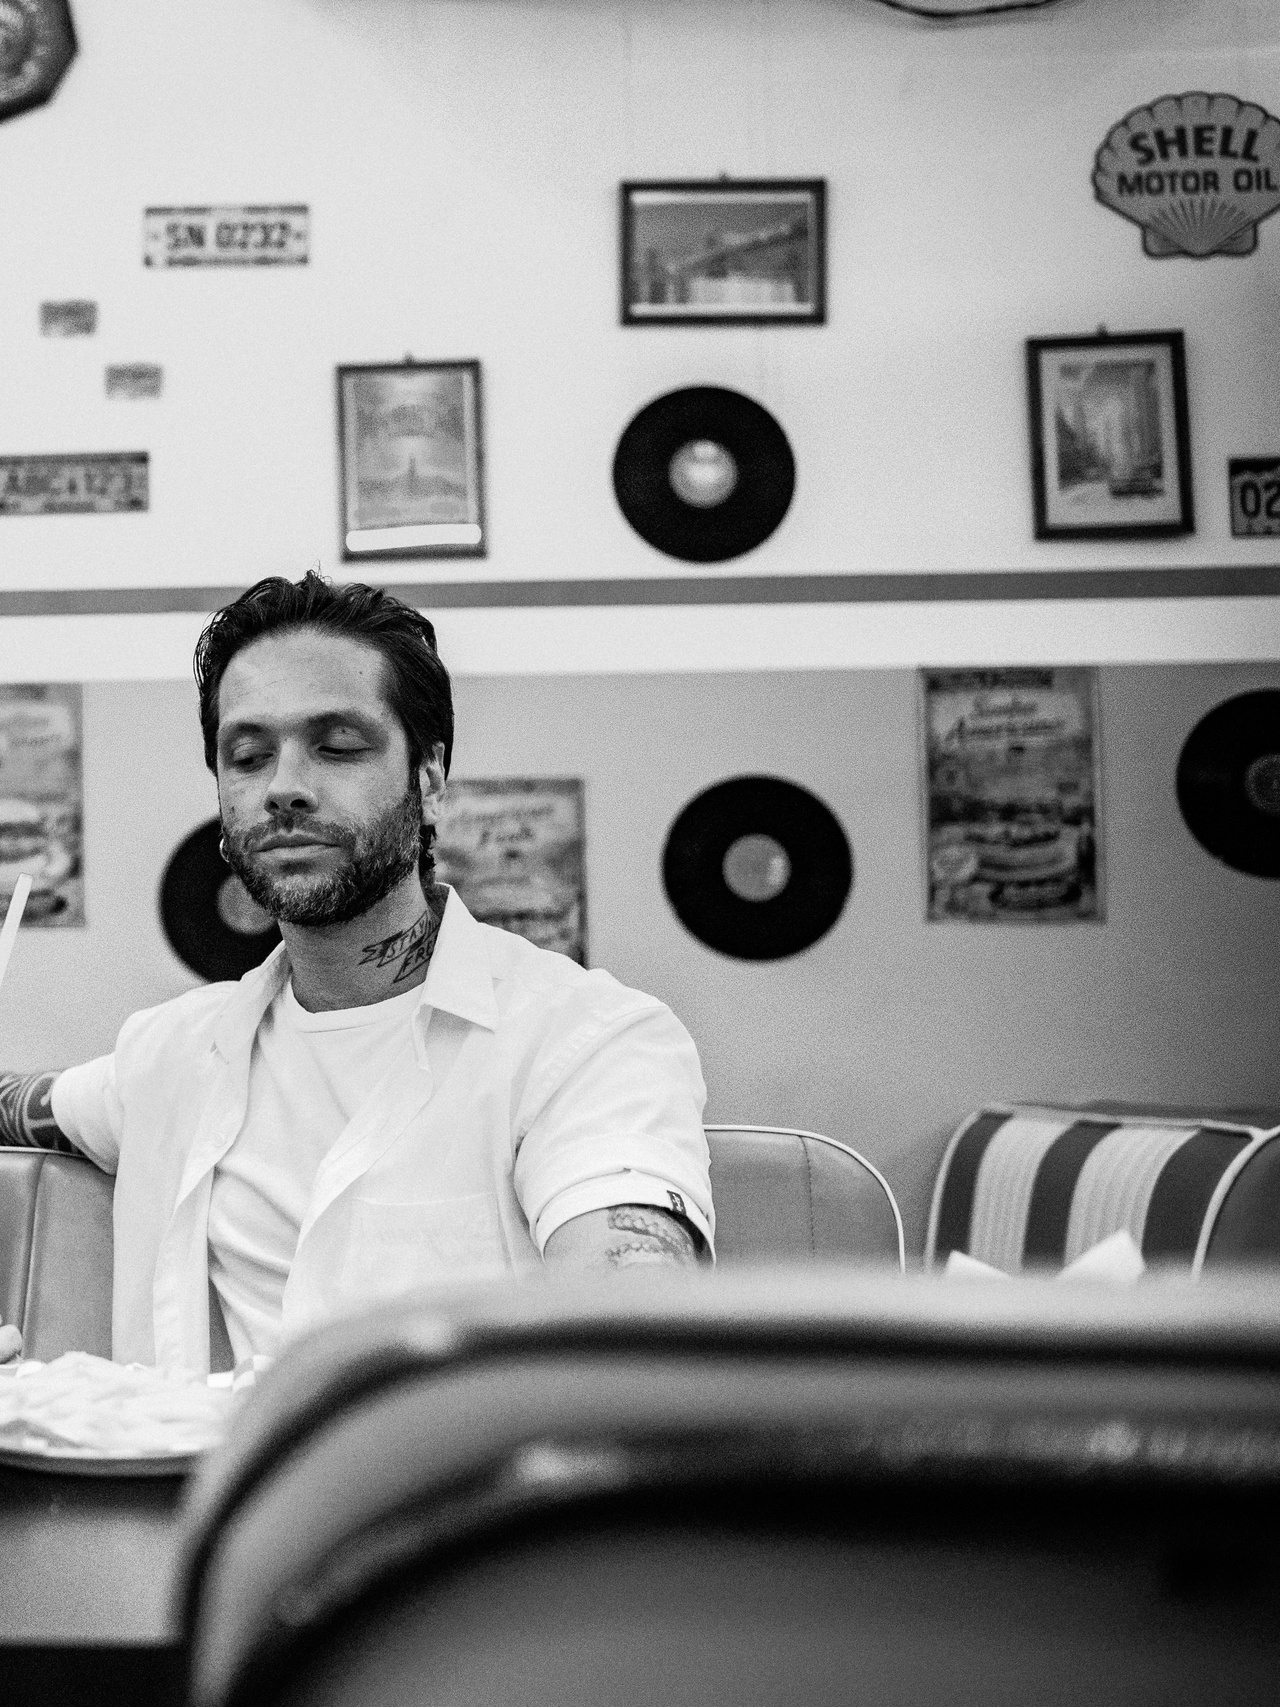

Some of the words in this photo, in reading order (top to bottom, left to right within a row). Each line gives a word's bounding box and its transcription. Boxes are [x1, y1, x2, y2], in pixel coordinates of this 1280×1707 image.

[1129, 124, 1260, 167] SHELL
[1117, 169, 1220, 197] MOTOR
[1232, 167, 1279, 193] OIL
[386, 919, 427, 958] STAY
[402, 940, 434, 973] FRE
